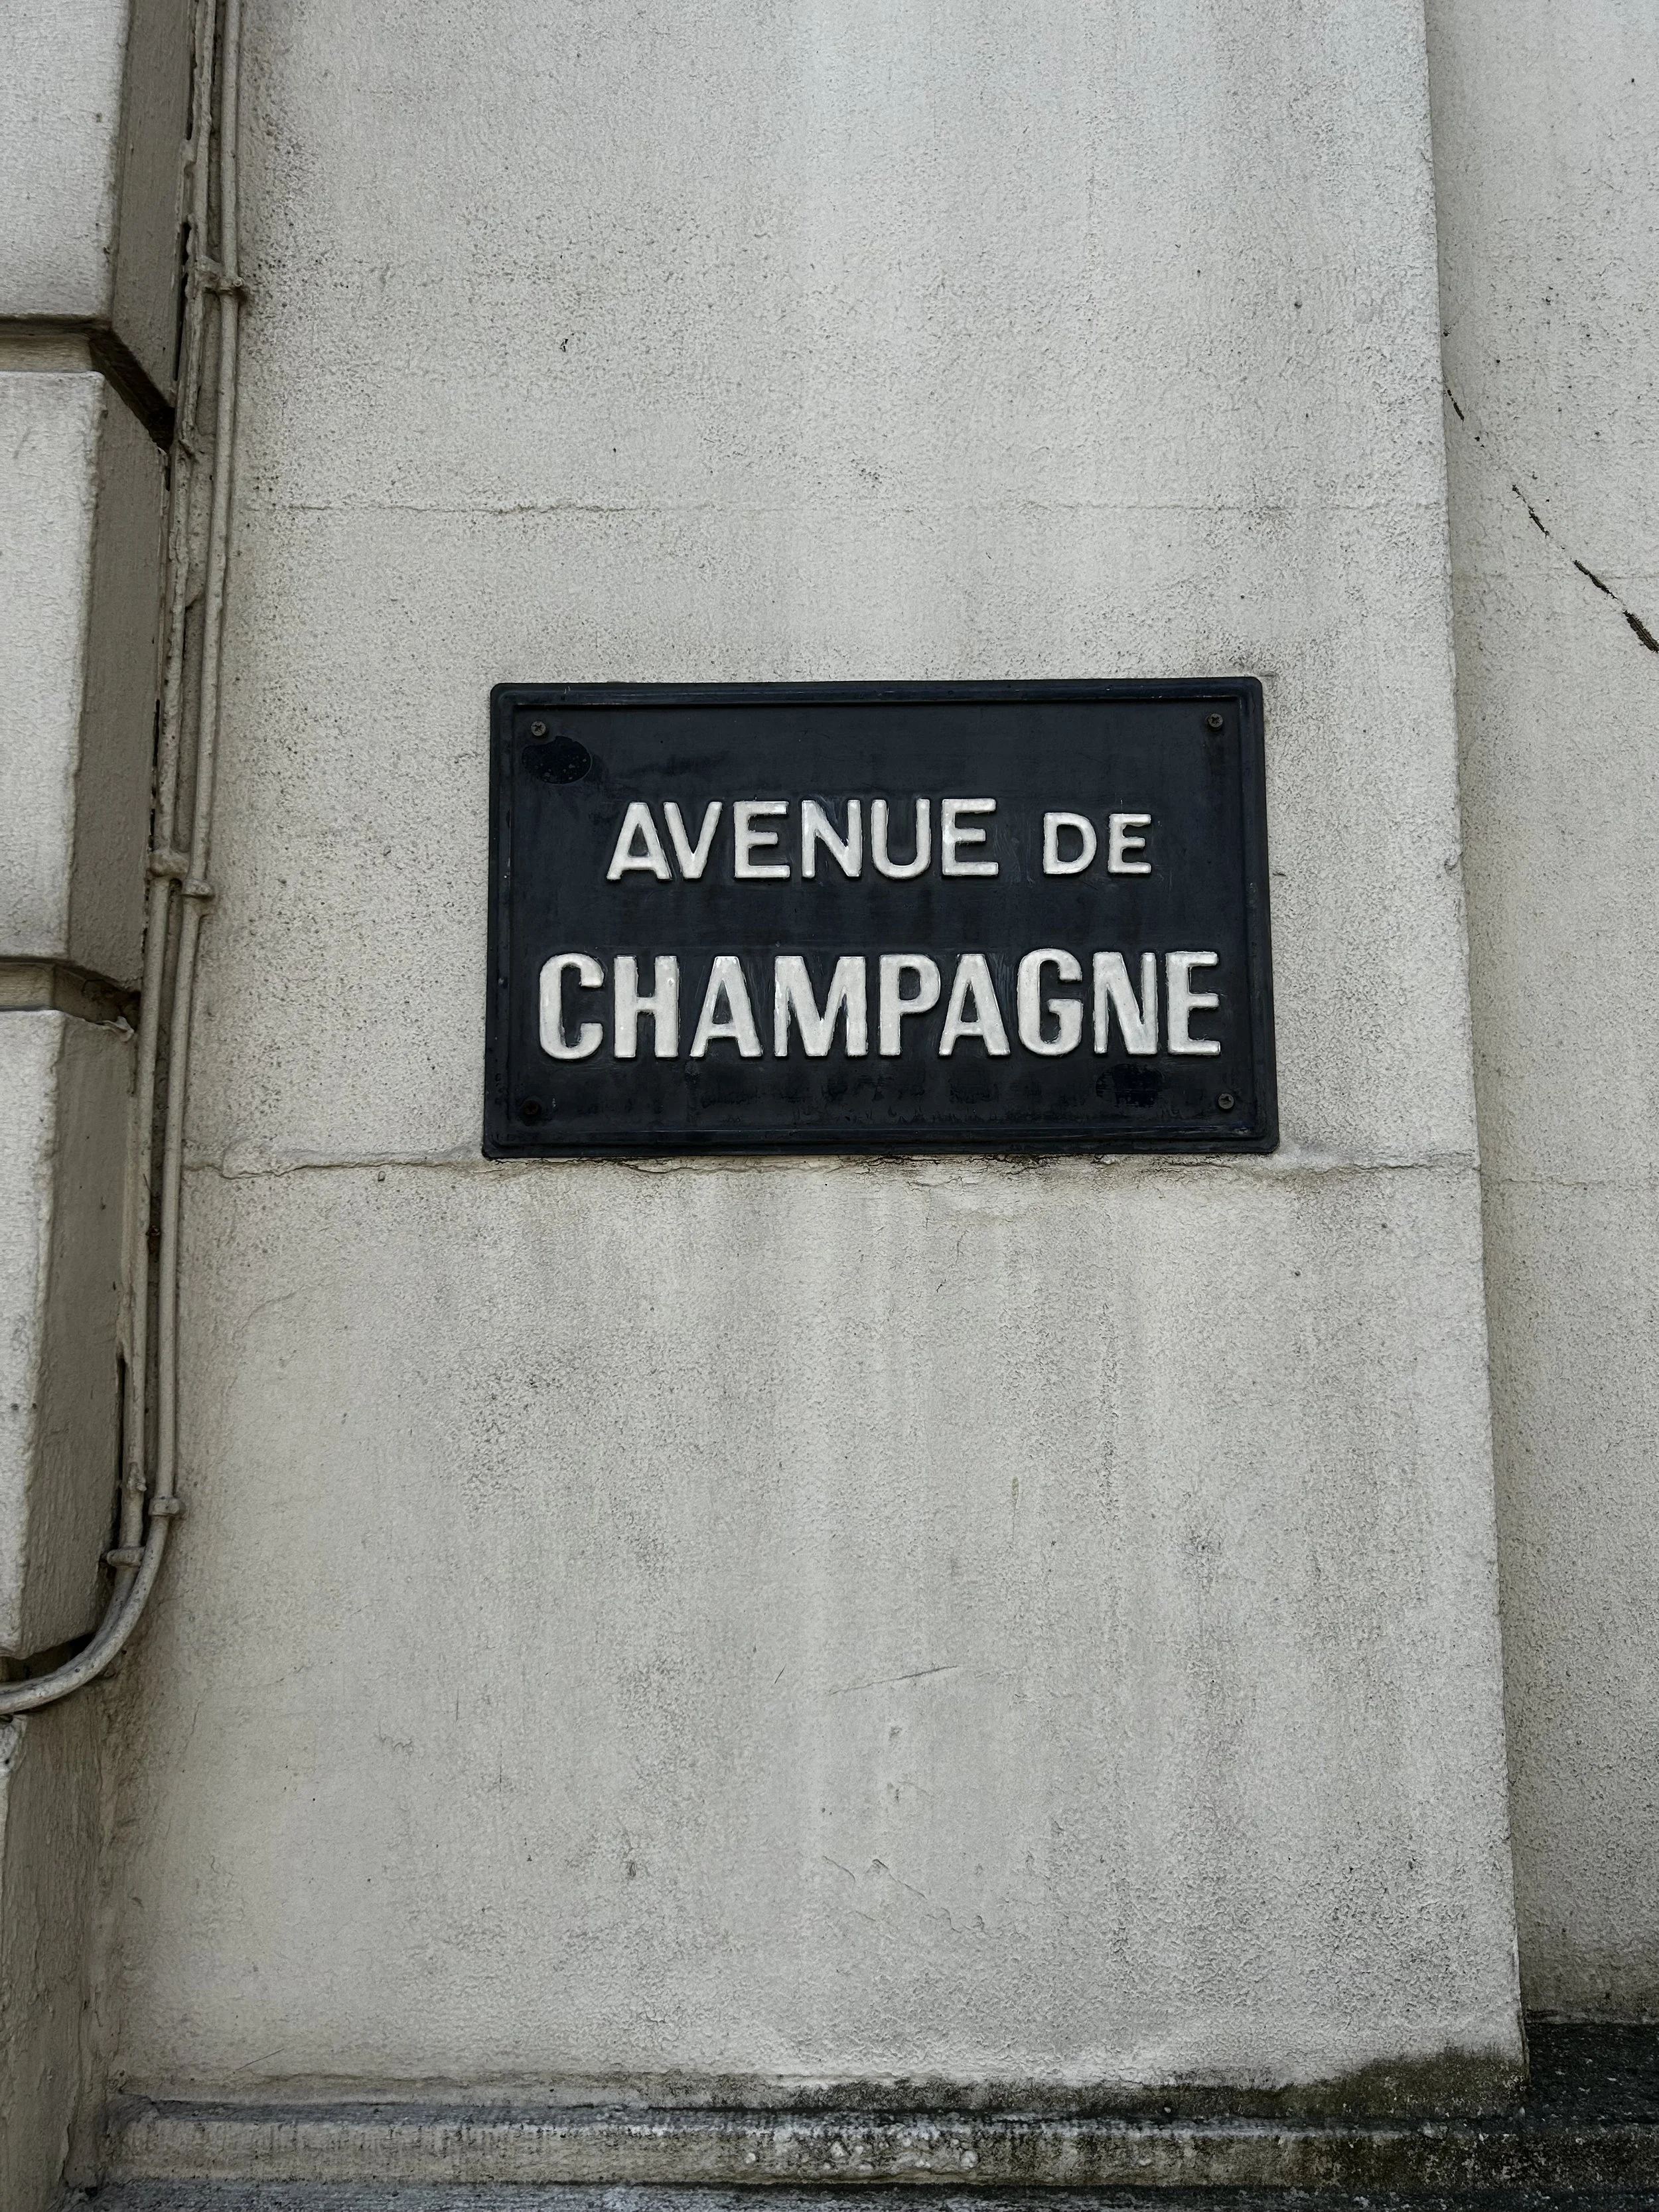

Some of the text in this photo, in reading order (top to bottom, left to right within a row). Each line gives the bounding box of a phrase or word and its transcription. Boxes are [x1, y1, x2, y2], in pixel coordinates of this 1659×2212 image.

[606, 797, 1153, 880] AVENUE DE
[539, 947, 1222, 1060] CHAMPAGNE
